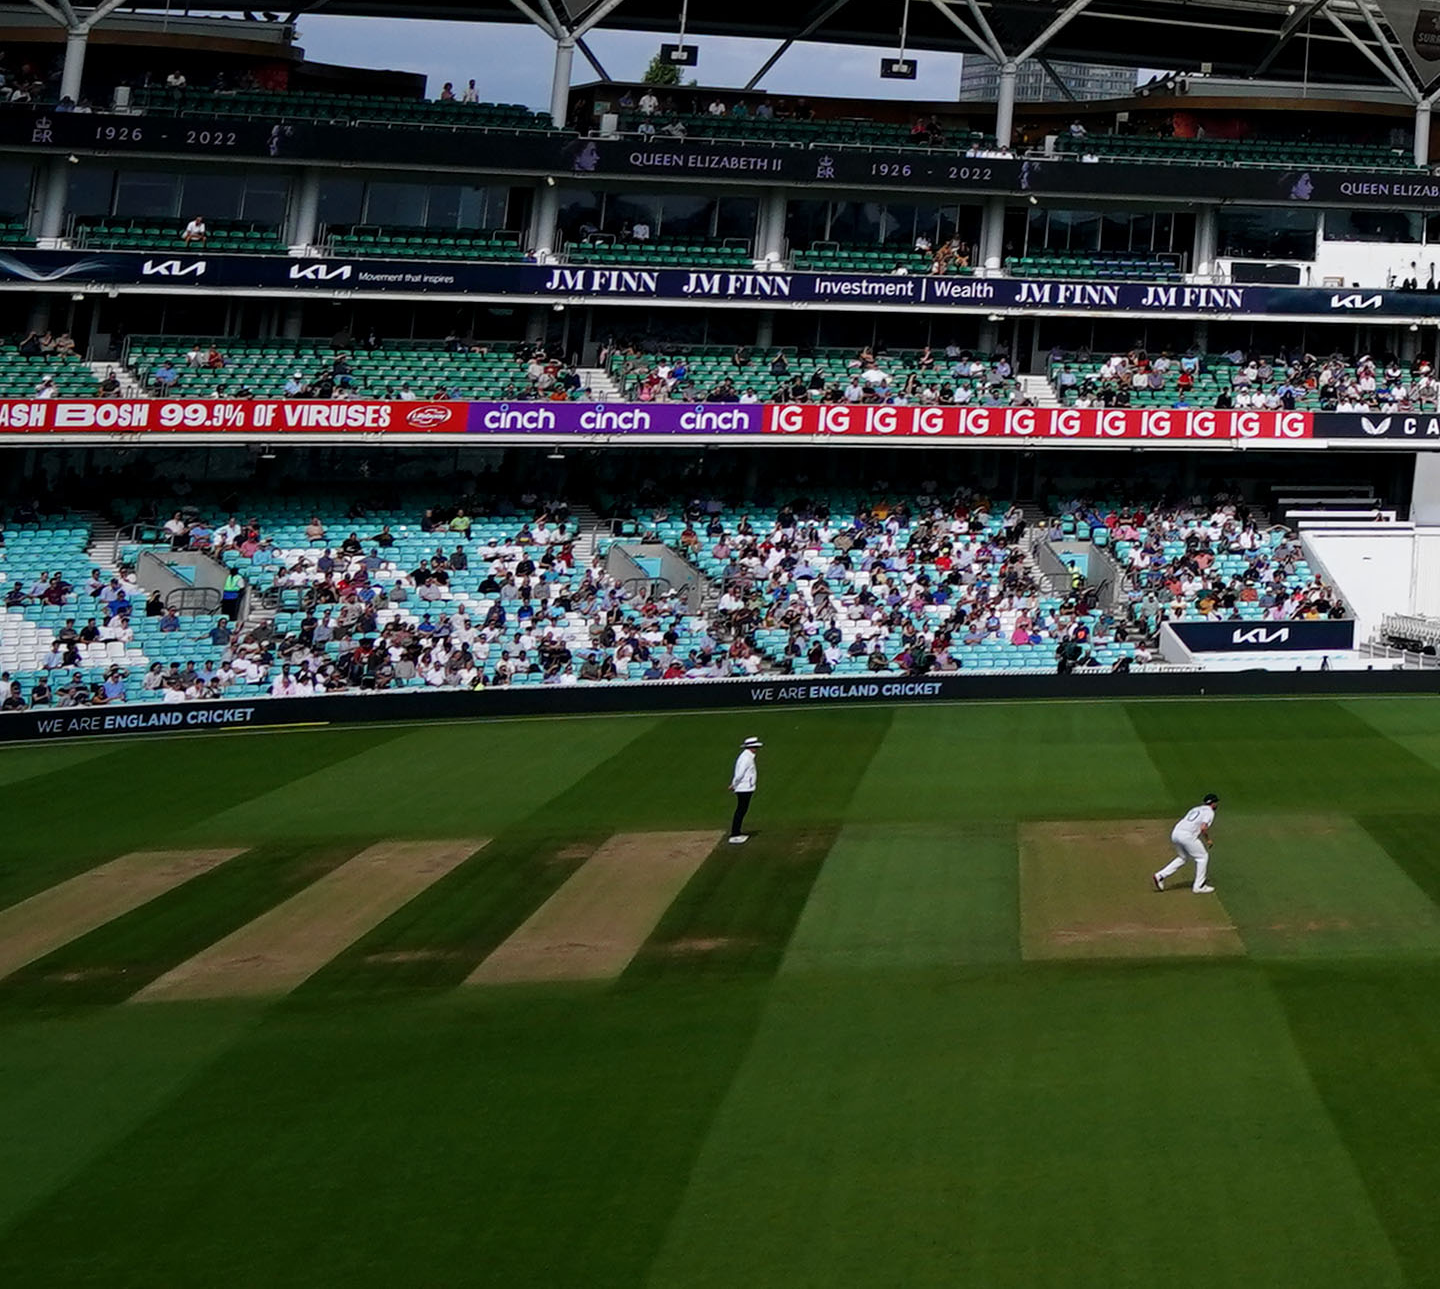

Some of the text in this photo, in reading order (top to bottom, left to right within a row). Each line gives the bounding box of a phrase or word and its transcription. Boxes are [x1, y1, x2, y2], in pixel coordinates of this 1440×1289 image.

[96, 127, 236, 145] 1926 2022
[629, 152, 782, 171] QUEEN ELIZABETH II
[871, 164, 992, 181] 1926 2022
[1340, 182, 1389, 196] QUEEN
[358, 272, 454, 285] Movement that inspires
[545, 270, 660, 293] JM FINN
[683, 273, 792, 296] JM FINN
[815, 278, 994, 298] Investment Wealth
[1014, 283, 1120, 305] JM FINN
[1141, 286, 1244, 308] JM FINN
[54, 404, 149, 426] BOSH
[160, 404, 245, 426] 99.9%
[253, 404, 278, 426] OF
[283, 405, 392, 427] VIRUSES
[484, 404, 555, 430] cinch
[580, 405, 650, 430] cinch
[680, 405, 749, 431] cinch
[771, 406, 802, 432] IG
[818, 406, 849, 433] IG
[865, 407, 897, 433] IG
[911, 408, 943, 434] IG
[751, 682, 942, 701] WE ARE ENGLAND CRICKET
[37, 707, 255, 733] WE ARE ENGLAND CRICKET
